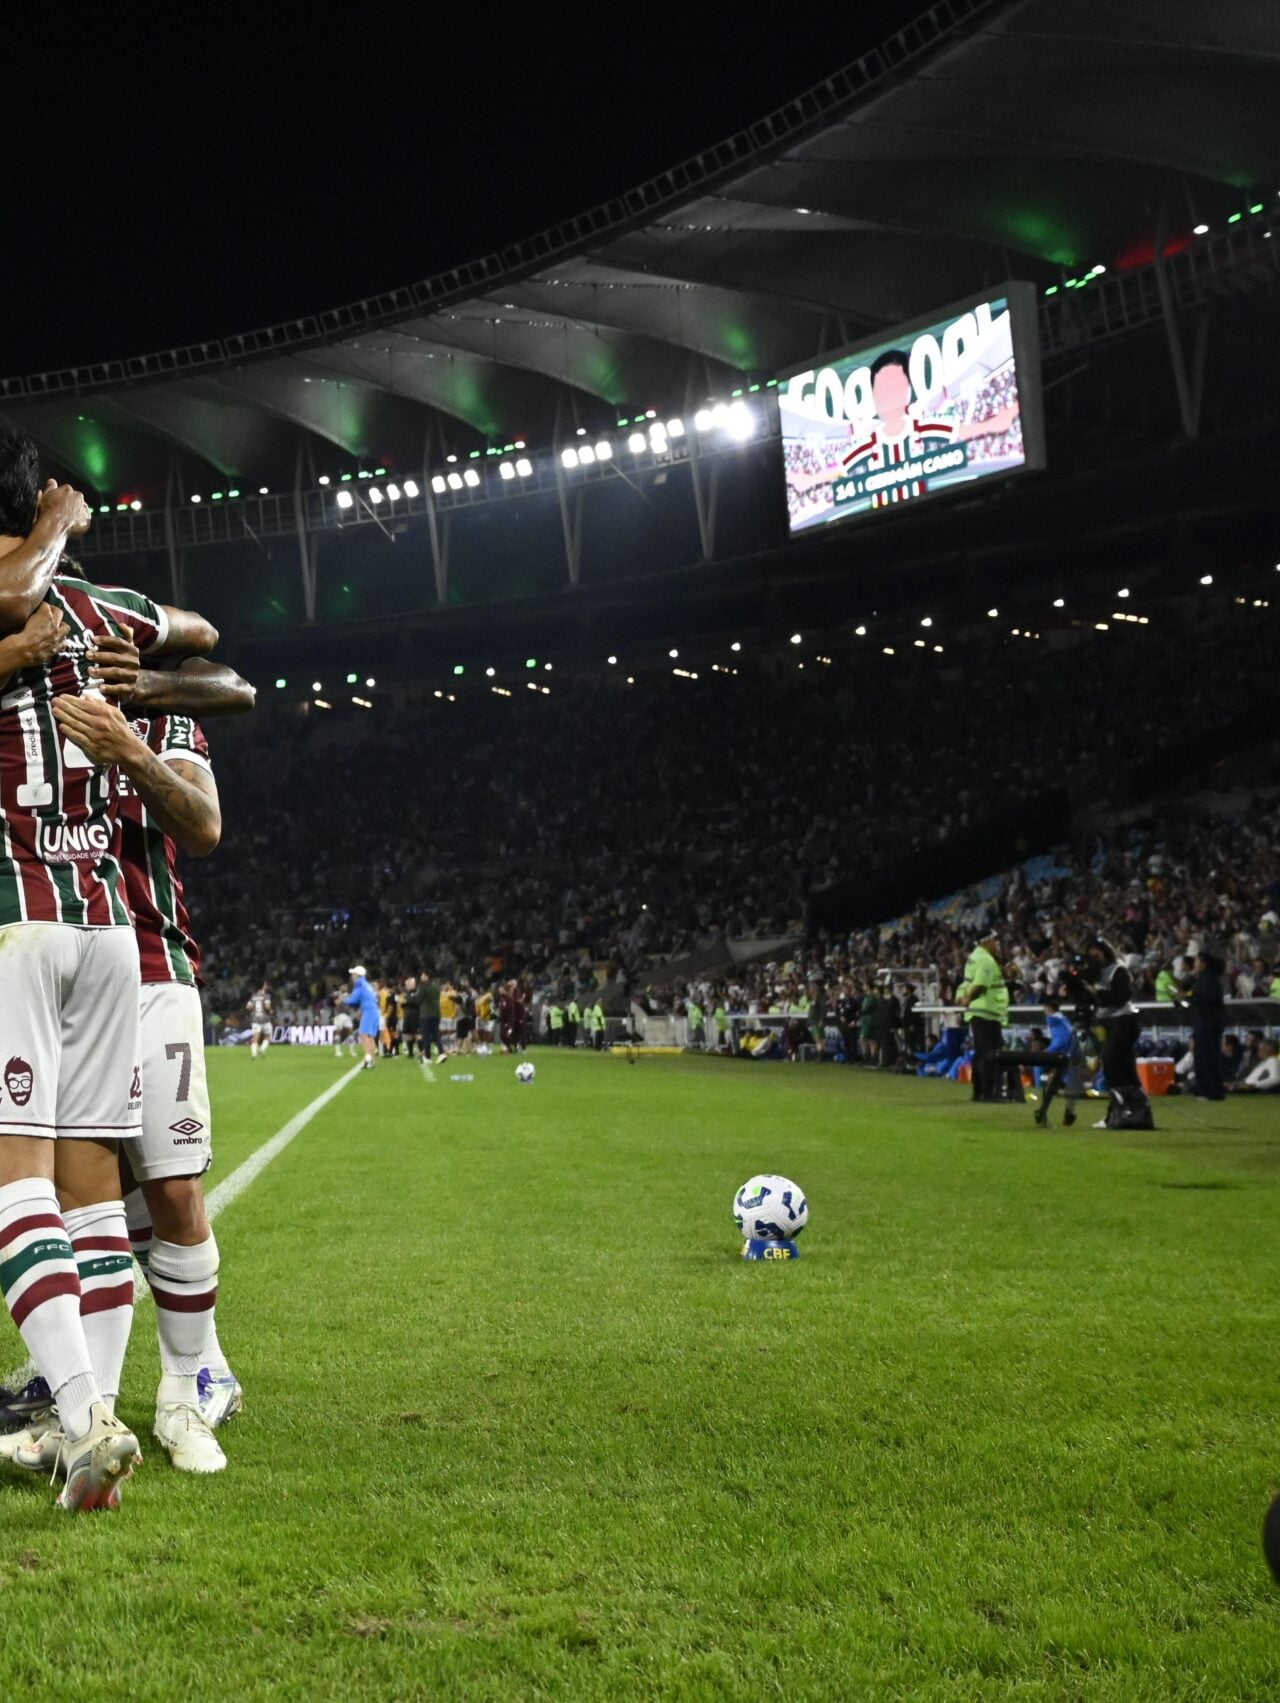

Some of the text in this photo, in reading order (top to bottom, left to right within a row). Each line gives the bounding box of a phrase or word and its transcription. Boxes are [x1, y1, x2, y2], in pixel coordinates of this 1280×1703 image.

[44, 824, 109, 852] UNIG
[165, 1042, 192, 1102] 7
[173, 1136, 202, 1145] umbro
[33, 1243, 69, 1255] FFC
[763, 1248, 791, 1260] CBF
[92, 1257, 127, 1270] FFC
